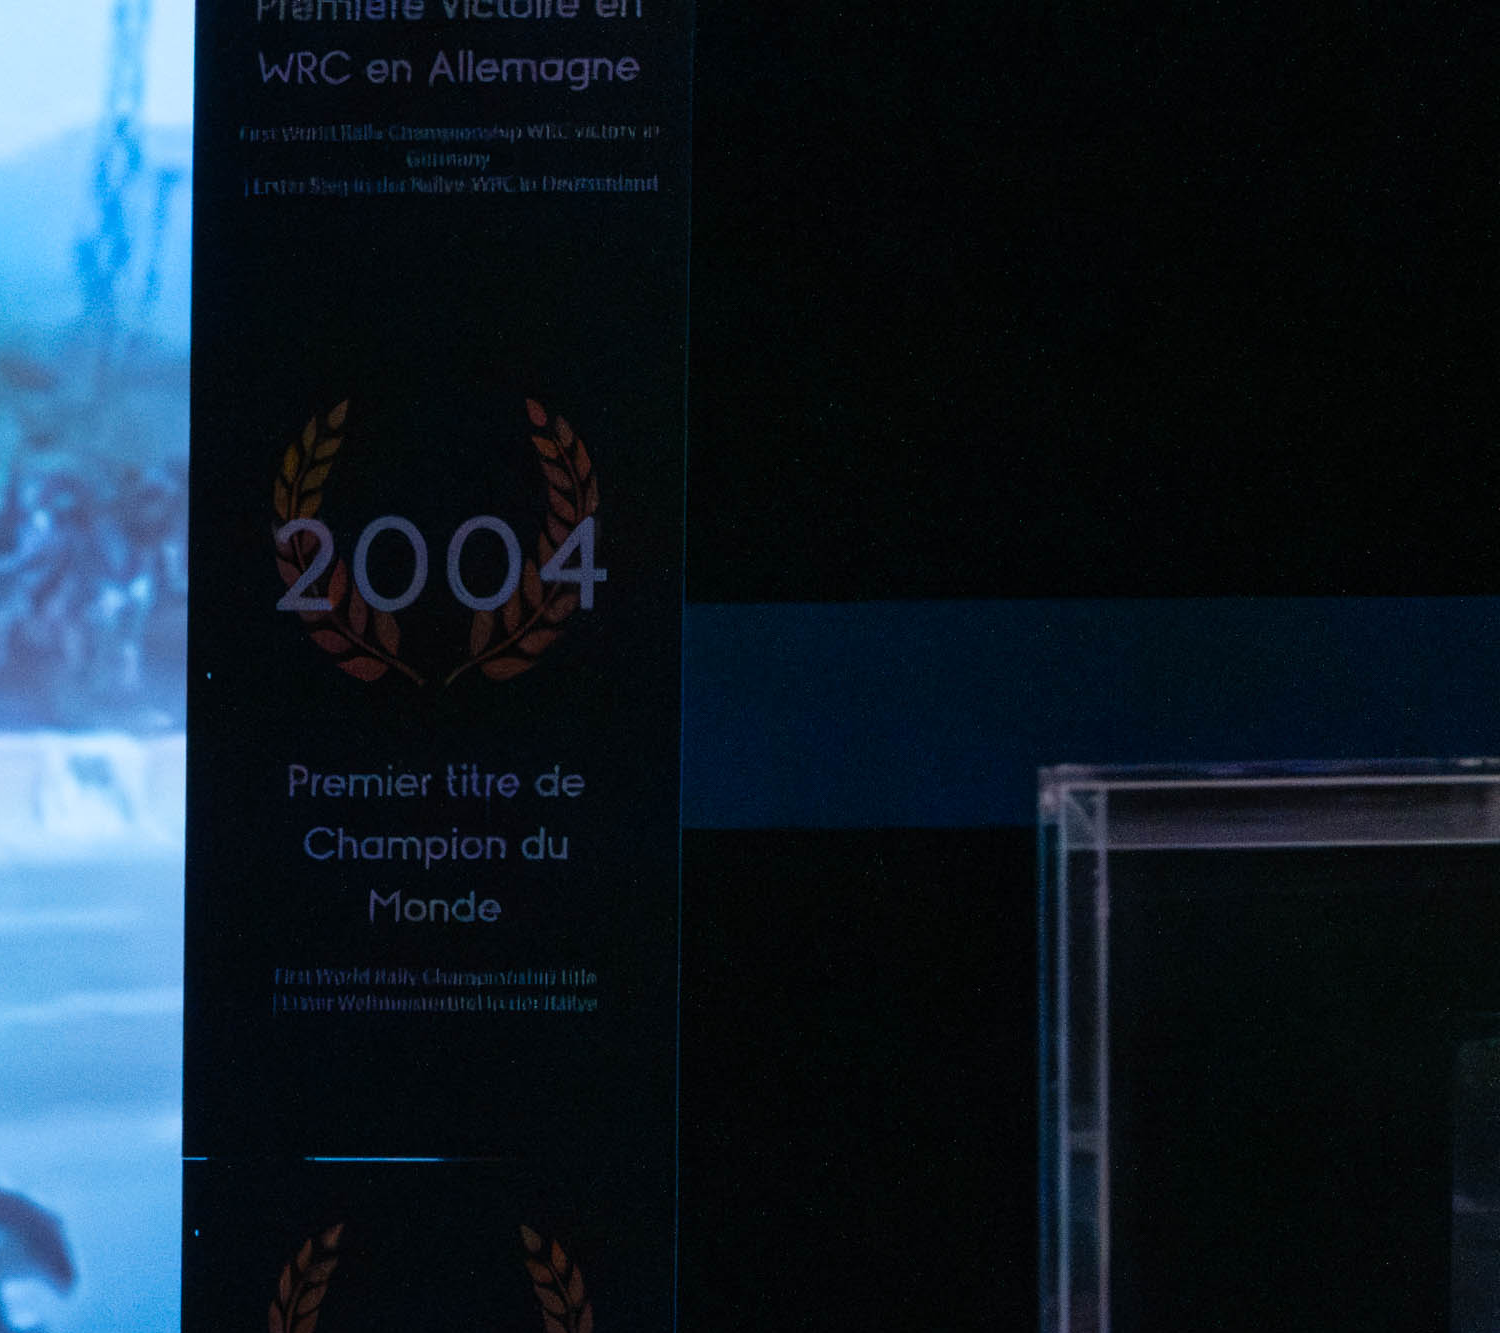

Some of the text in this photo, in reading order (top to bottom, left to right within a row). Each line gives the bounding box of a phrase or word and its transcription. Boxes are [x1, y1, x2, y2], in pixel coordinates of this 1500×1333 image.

[258, 49, 641, 92] WRC en Allemagne
[274, 512, 609, 614] 2004
[288, 763, 585, 800] Premier titre de
[303, 825, 569, 870] Champion du
[368, 888, 502, 923] Monde
